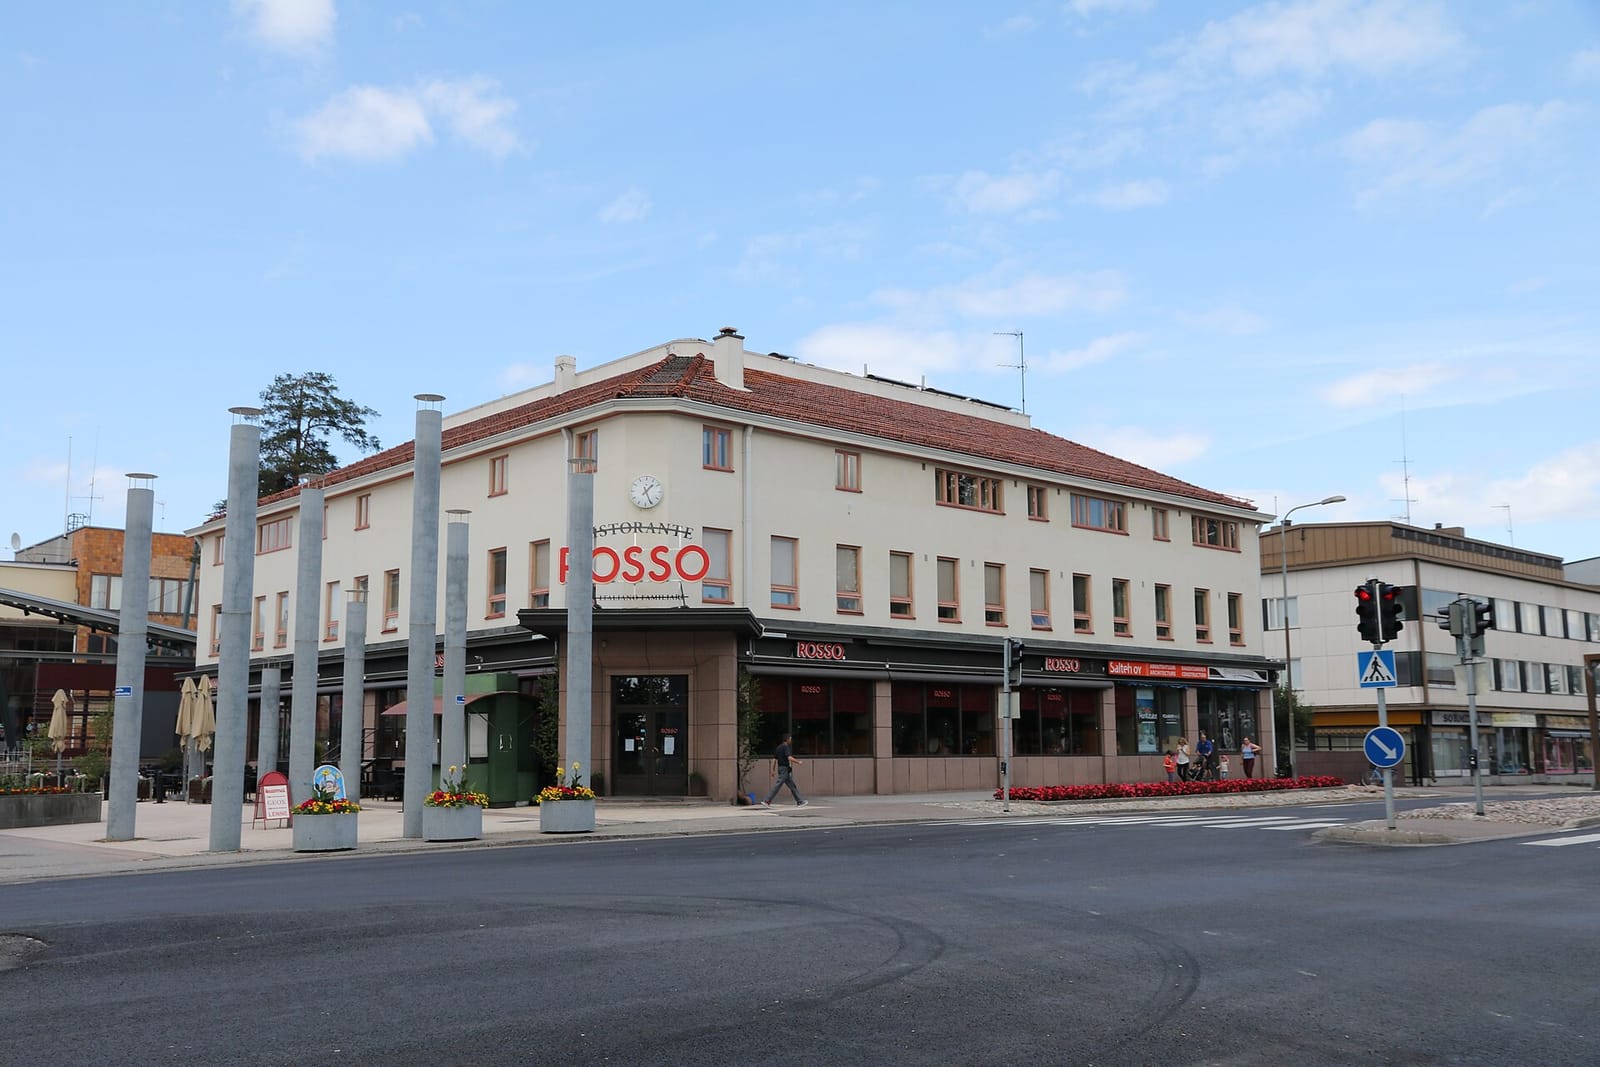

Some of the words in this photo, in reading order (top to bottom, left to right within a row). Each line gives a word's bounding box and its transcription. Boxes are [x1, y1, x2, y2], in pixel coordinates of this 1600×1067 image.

[592, 522, 694, 540] ISTORANTE
[797, 641, 845, 660] ROSSO
[1045, 657, 1080, 672] ROSSO
[1109, 661, 1132, 674] Salteh
